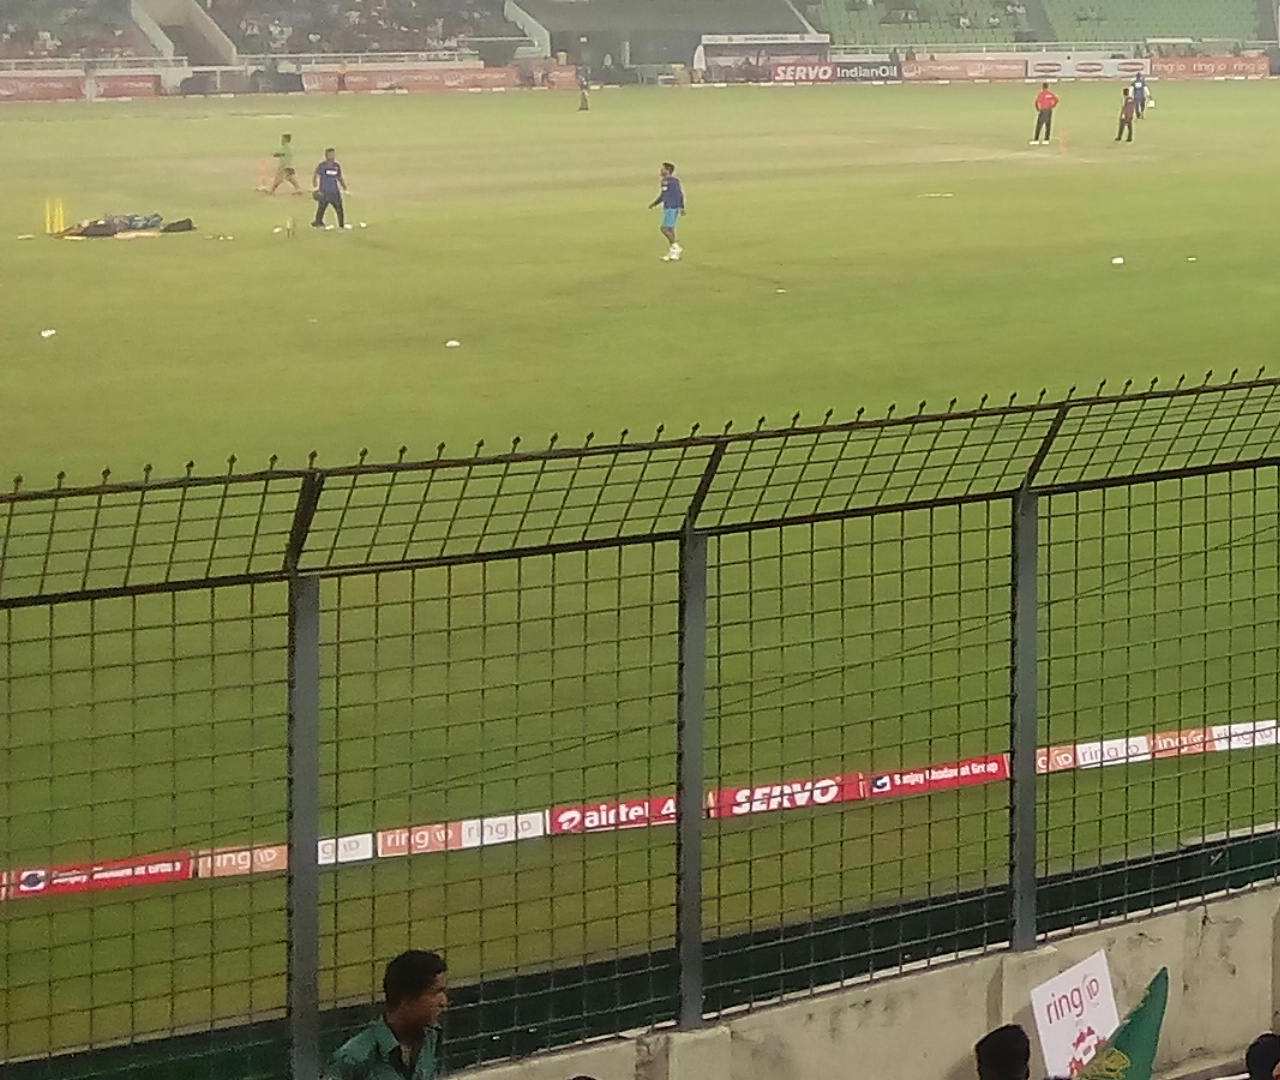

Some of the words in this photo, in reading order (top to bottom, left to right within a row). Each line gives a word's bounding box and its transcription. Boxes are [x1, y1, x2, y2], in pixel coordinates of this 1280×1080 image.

[775, 65, 833, 80] SERVO
[836, 65, 897, 78] IndianOil
[732, 779, 839, 814] SERVO
[584, 802, 649, 828] airtel
[661, 799, 676, 818] 4
[387, 829, 429, 848] ring
[468, 820, 508, 839] ring
[1046, 987, 1084, 1024] ring
[1086, 978, 1099, 1000] ID
